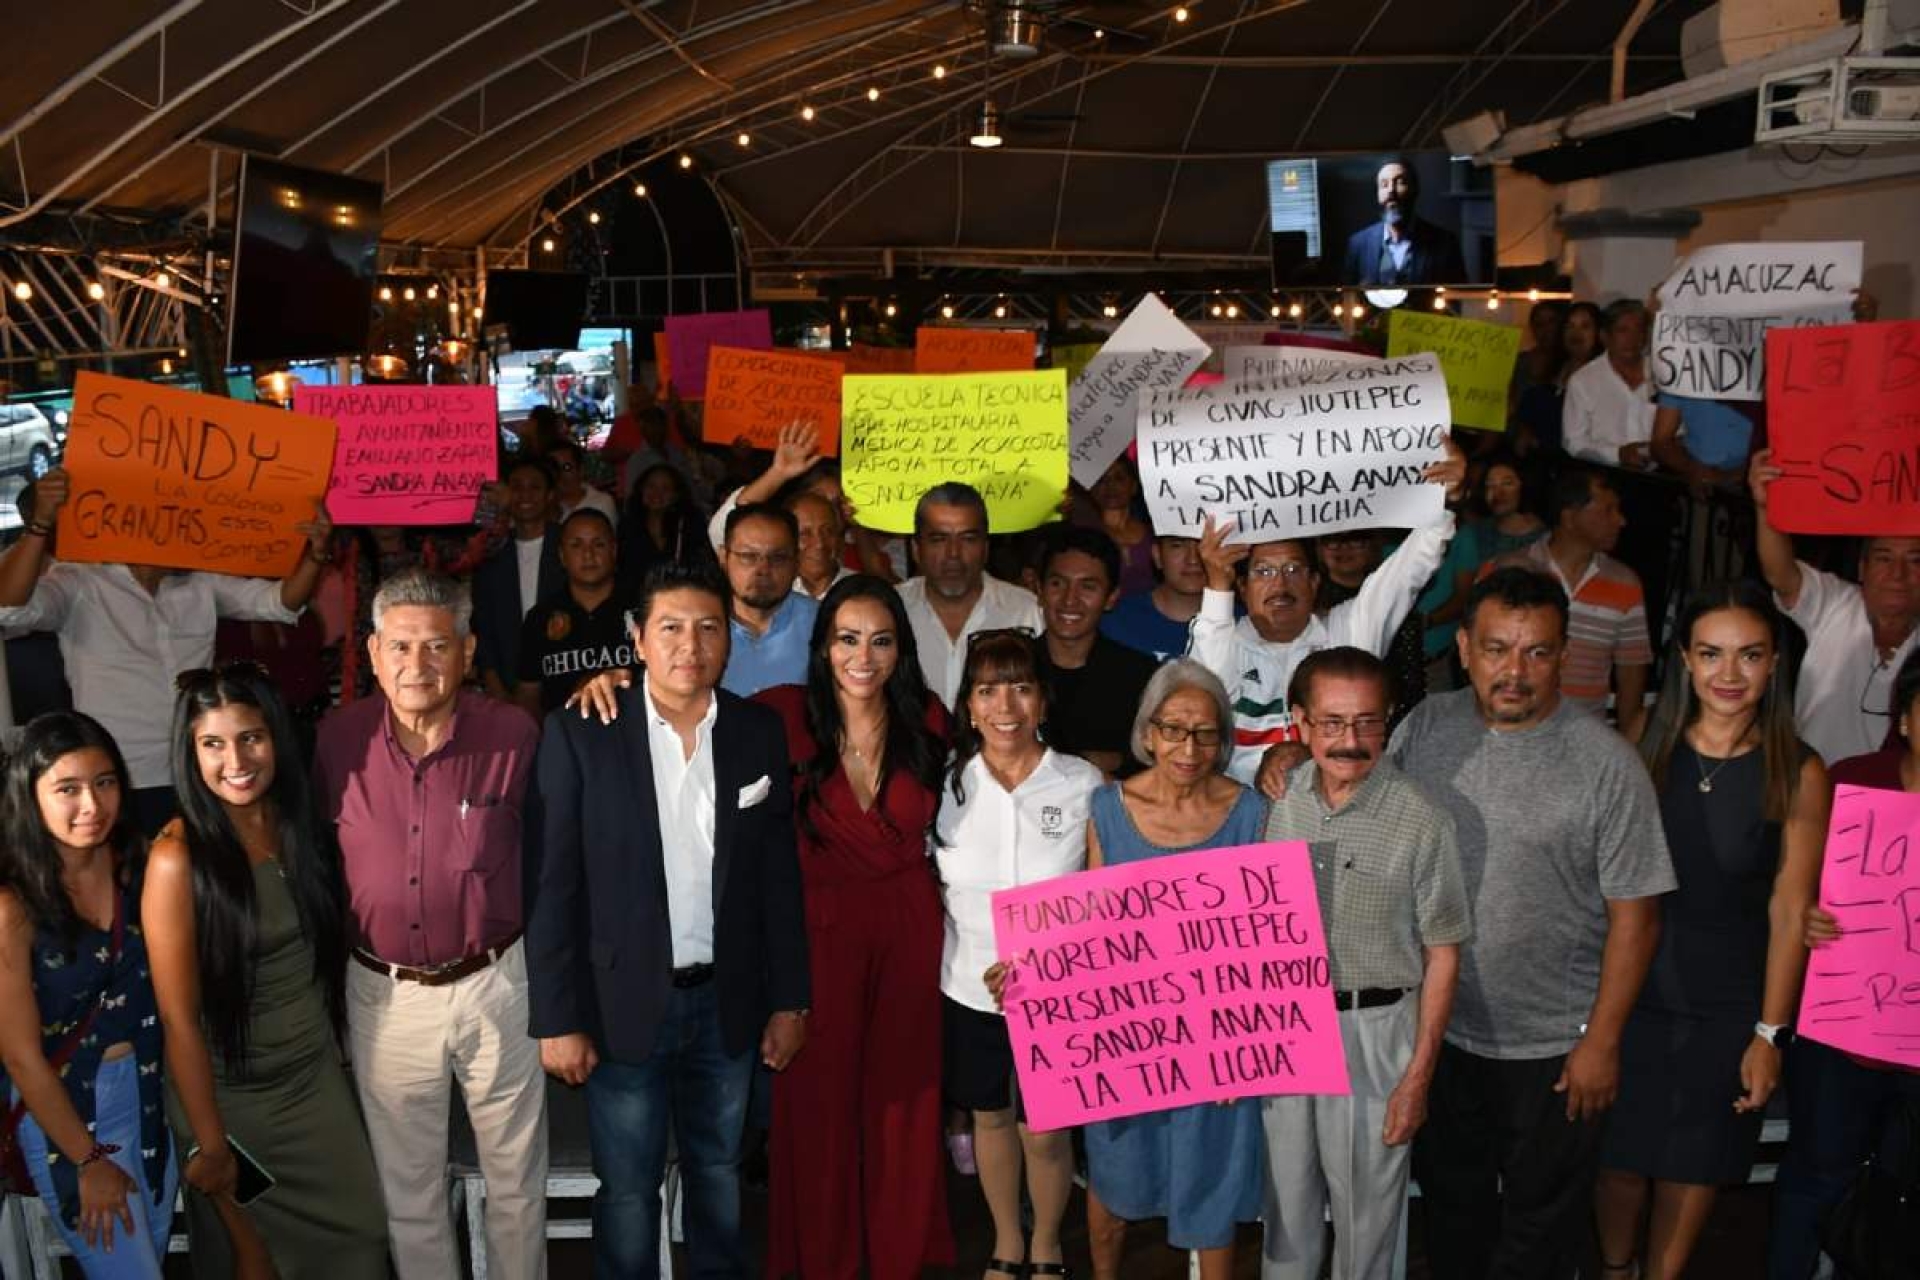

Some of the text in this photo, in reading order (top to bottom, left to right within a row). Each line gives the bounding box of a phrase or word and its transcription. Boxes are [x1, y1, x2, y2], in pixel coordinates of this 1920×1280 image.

[1674, 263, 1836, 298] AMACUZAC
[1657, 346, 1756, 393] SANDY
[303, 392, 475, 418] TRABAJADORES
[853, 382, 1064, 412] ESCUELA TECNICA
[1151, 409, 1178, 428] DE
[92, 392, 281, 491] SANDY
[345, 447, 432, 467] EMILIANO
[850, 436, 926, 453] MEDICA
[933, 436, 960, 454] DE
[1151, 431, 1277, 467] PRESENTE
[1288, 430, 1304, 456] Y
[1316, 427, 1353, 458] EN
[357, 472, 426, 495] SANDRA
[855, 456, 1036, 476] APOYA TOTAL A
[1159, 477, 1176, 500] A
[1194, 468, 1341, 503] SANDRA
[75, 489, 207, 547] GRANJAS
[1000, 863, 1291, 934] FUNDADORES DE
[1012, 912, 1308, 983] MORENA JIUTEPEC
[1022, 955, 1330, 1031] PRESENTES Y EN APOYO
[1031, 1001, 1313, 1072] A SANDRA ANAYA
